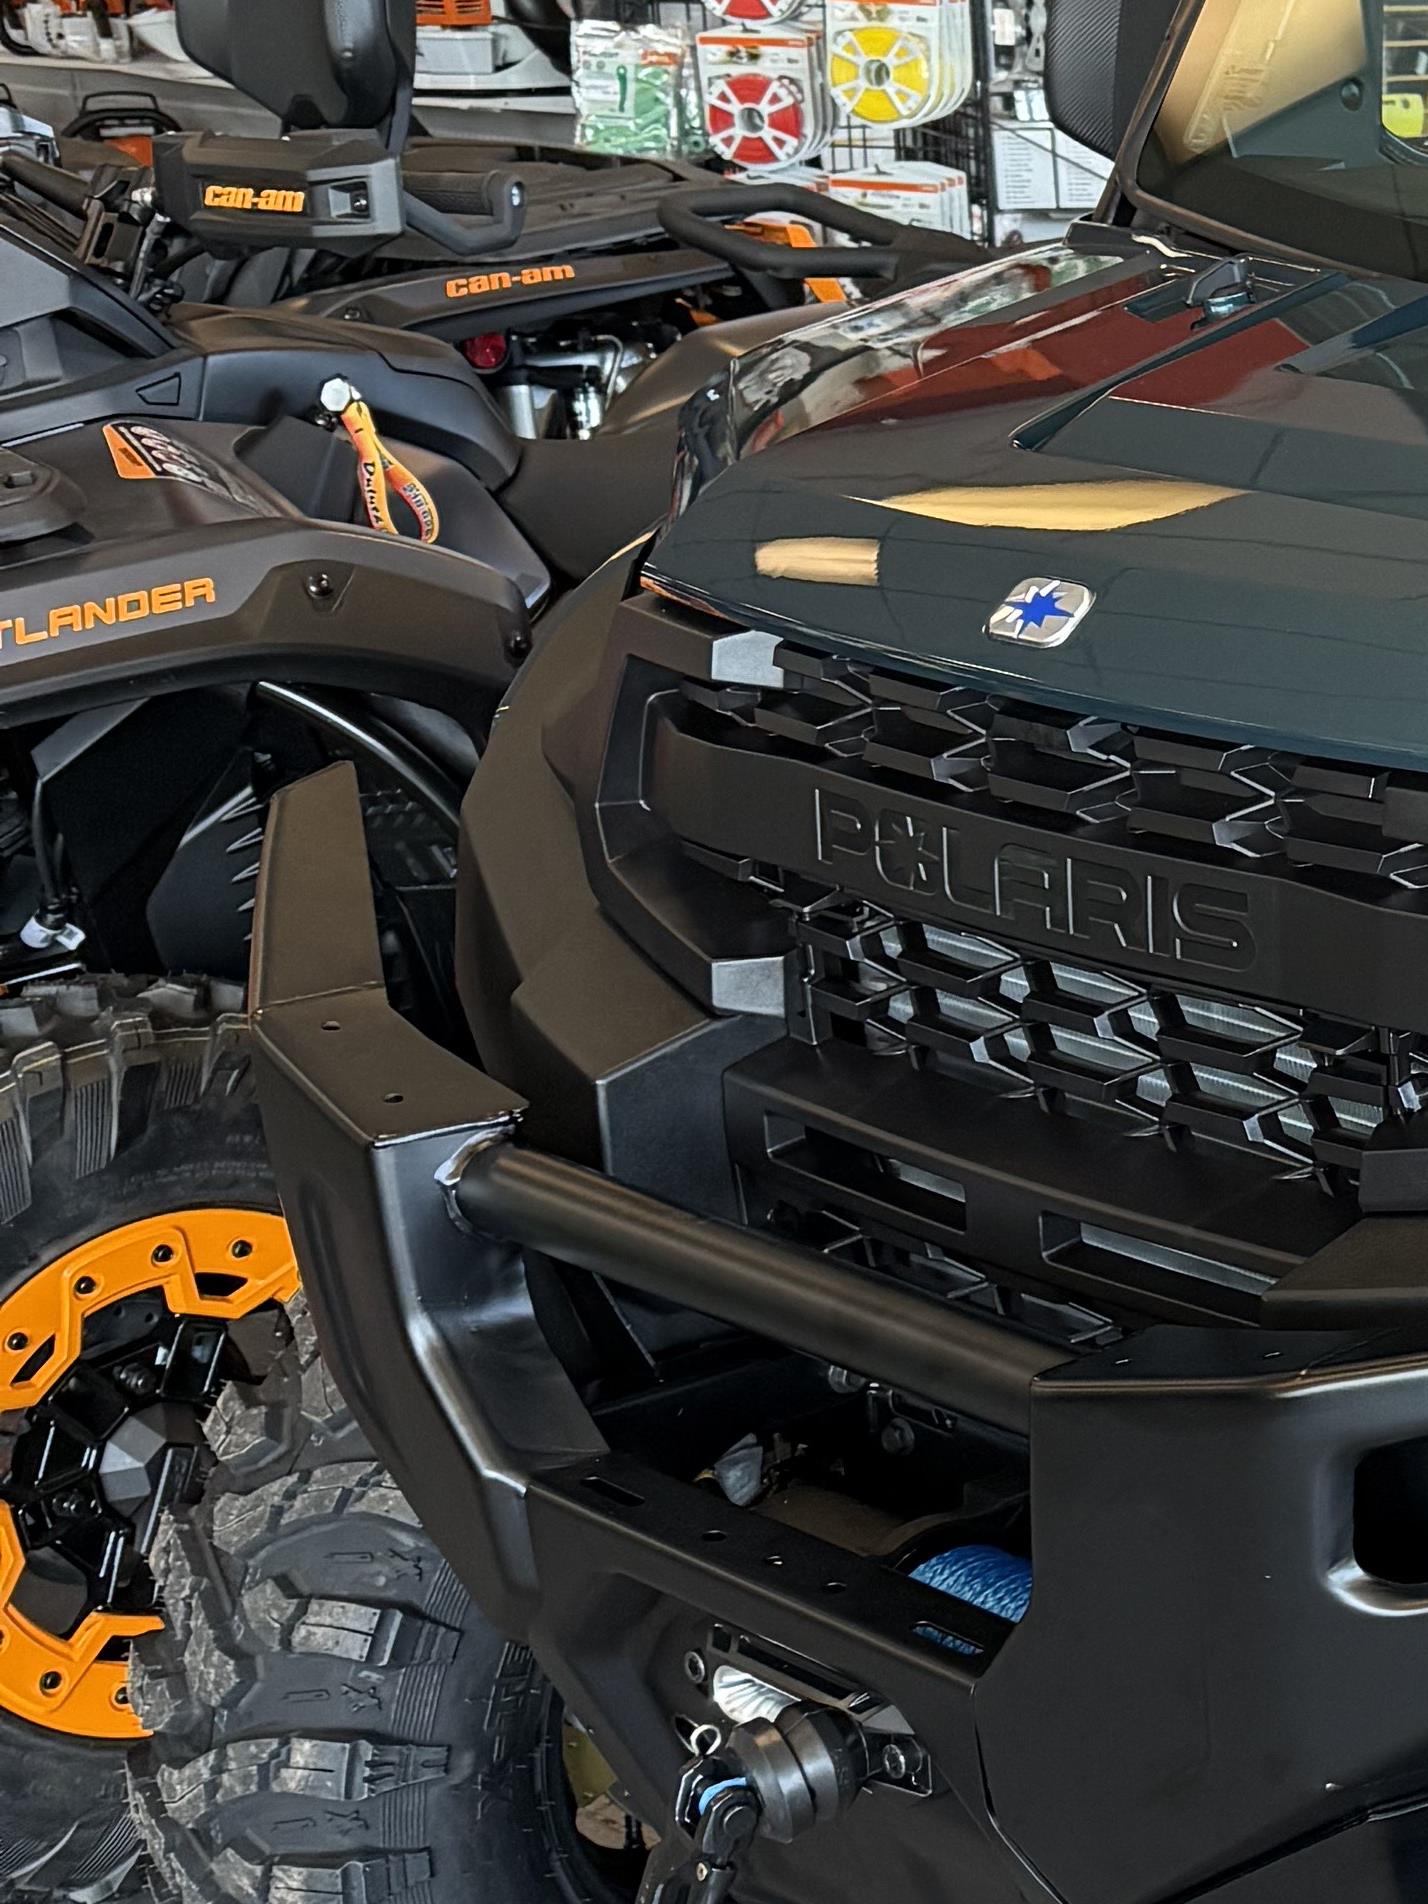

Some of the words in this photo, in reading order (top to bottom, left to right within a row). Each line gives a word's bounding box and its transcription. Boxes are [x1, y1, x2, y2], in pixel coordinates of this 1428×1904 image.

[204, 185, 305, 213] can-am
[446, 264, 575, 298] can-am
[811, 786, 1260, 973] POLARIS
